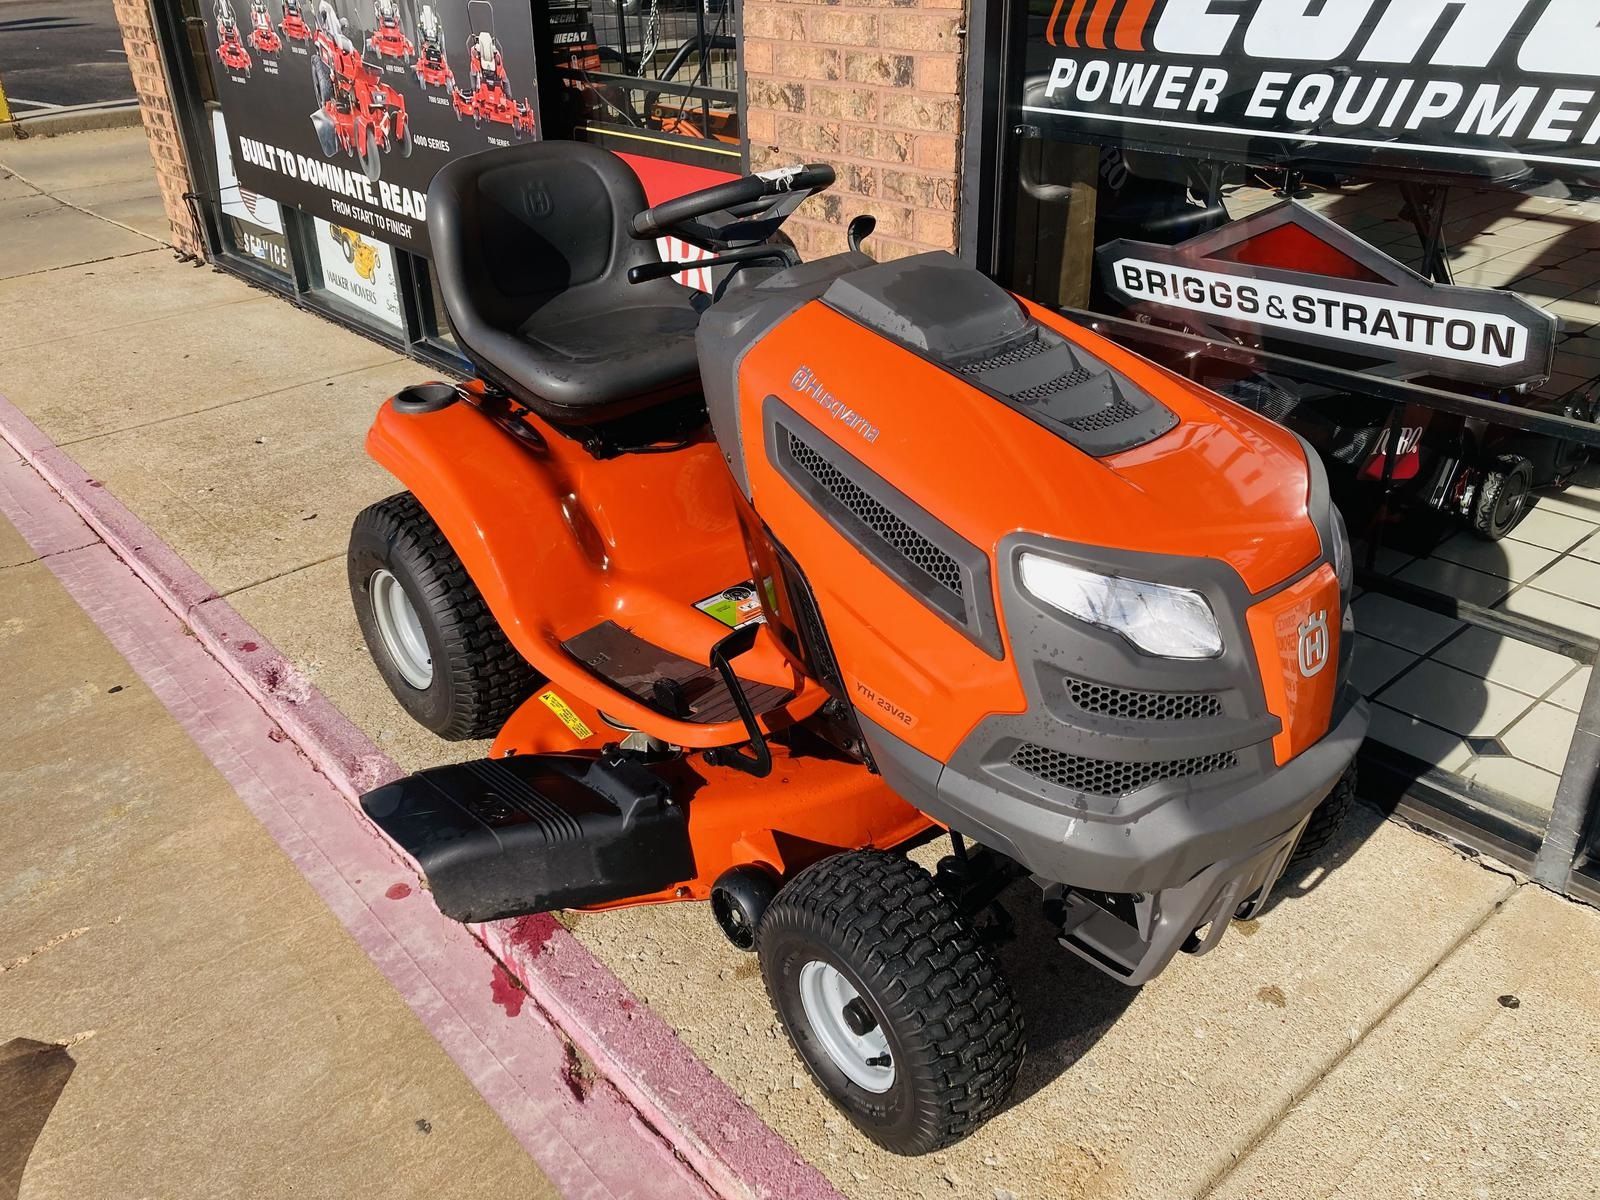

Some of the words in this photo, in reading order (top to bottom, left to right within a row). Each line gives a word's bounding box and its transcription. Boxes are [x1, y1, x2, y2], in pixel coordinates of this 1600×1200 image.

[1044, 57, 1229, 113] POWER
[427, 137, 450, 152] SERIES
[239, 135, 277, 171] BUILT
[276, 147, 297, 178] TO
[296, 154, 379, 206] DOMINATE.
[378, 180, 428, 222] READ
[331, 198, 351, 217] FROM
[351, 205, 375, 226] START
[374, 212, 386, 228] TO
[385, 214, 412, 239] FINISH
[326, 269, 349, 291] WALKER
[349, 280, 377, 305] MOWERS
[1121, 264, 1260, 314] BRIGGS
[1292, 294, 1516, 359] STRATTON
[803, 372, 880, 443] Husqvarna
[856, 682, 875, 701] YTH
[877, 697, 913, 726] 23V42
